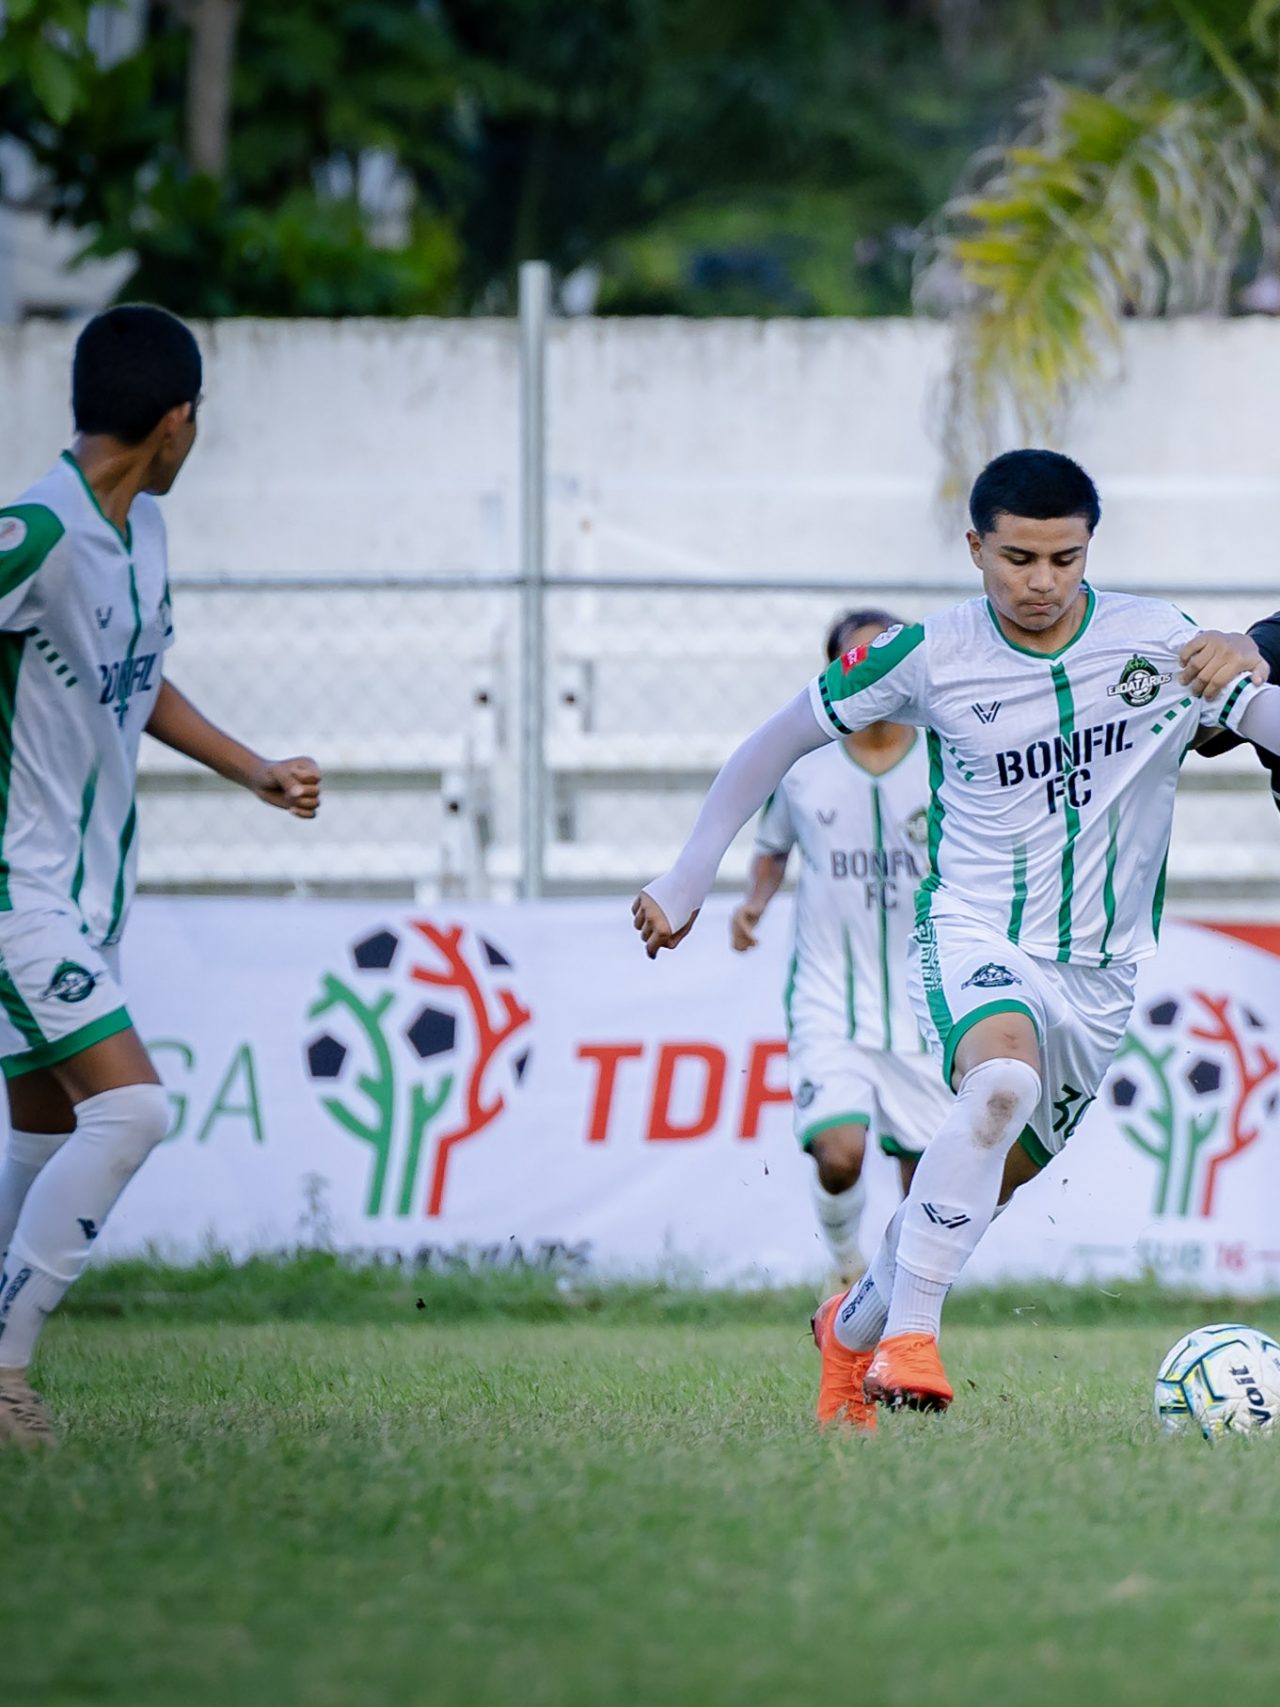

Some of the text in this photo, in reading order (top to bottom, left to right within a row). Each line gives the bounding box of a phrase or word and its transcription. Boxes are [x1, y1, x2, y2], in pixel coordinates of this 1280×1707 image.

[996, 719, 1134, 787] BONFIL
[1047, 768, 1092, 815] FC
[865, 882, 897, 911] FC
[145, 1041, 263, 1142] GA
